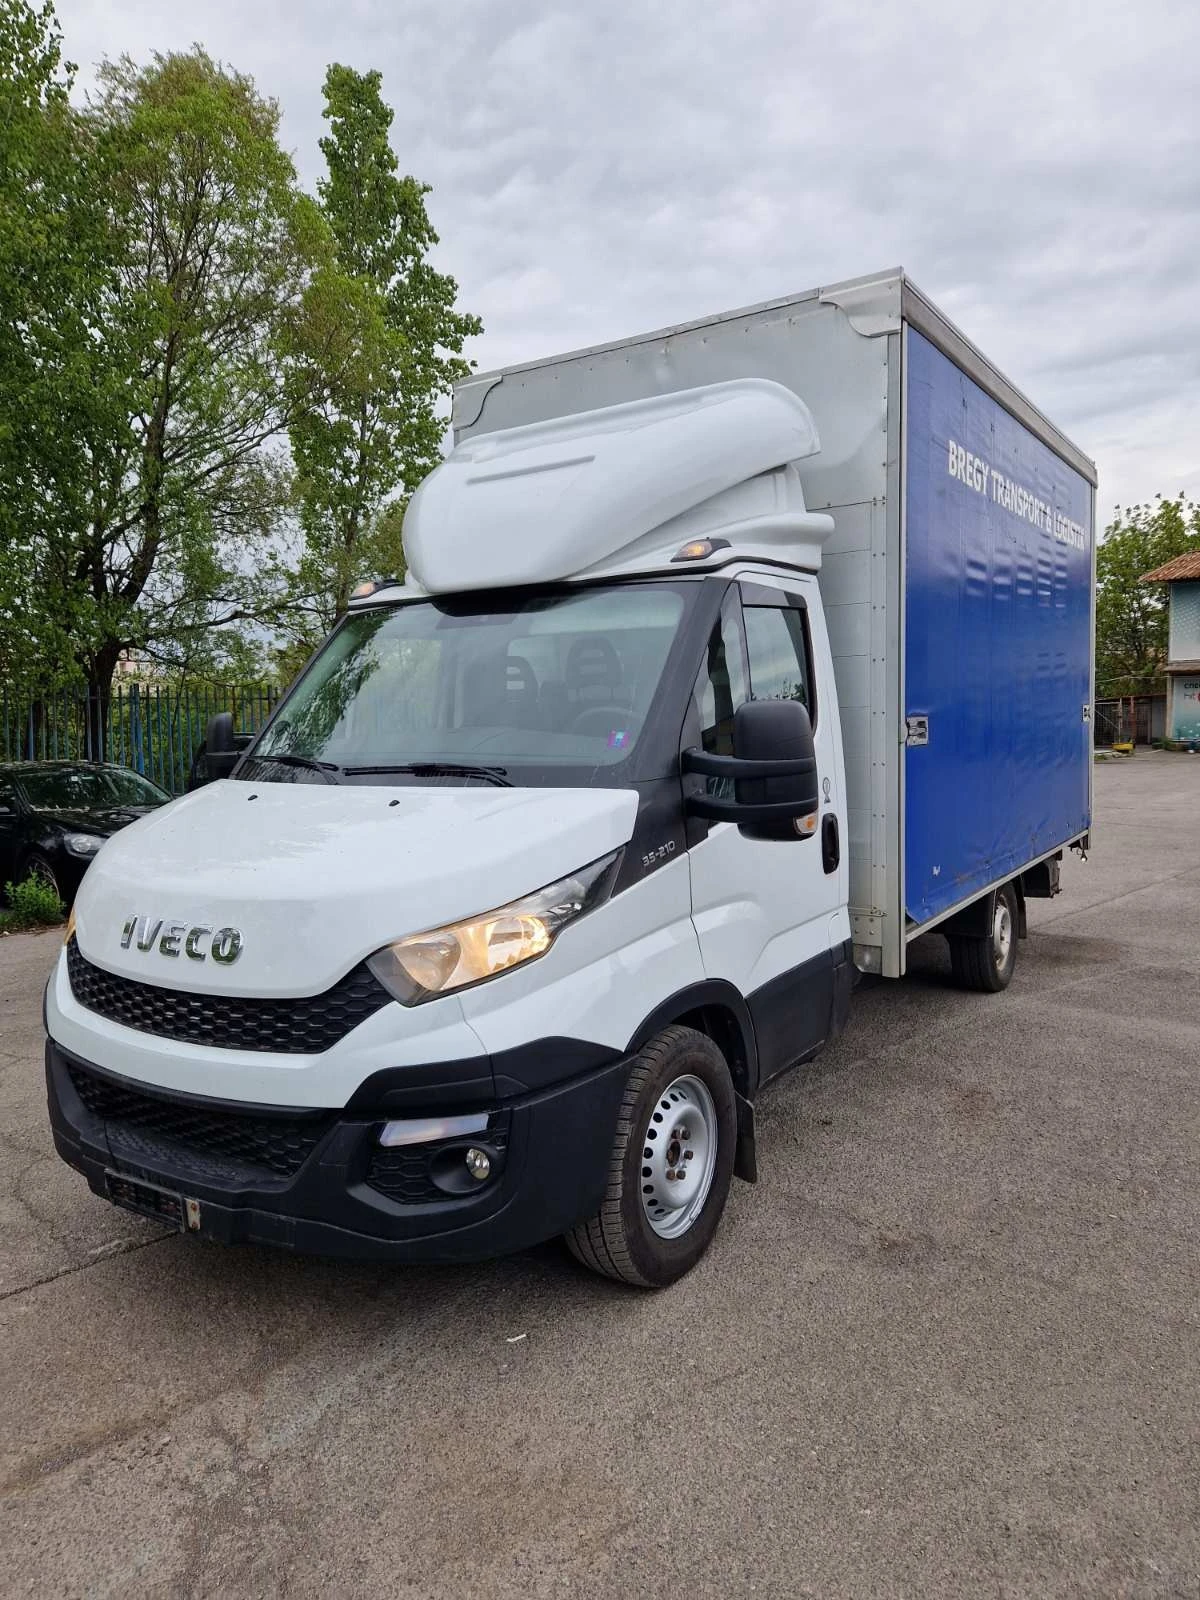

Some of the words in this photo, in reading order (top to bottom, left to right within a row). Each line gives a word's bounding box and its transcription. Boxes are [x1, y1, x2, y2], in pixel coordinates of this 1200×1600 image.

[948, 440, 989, 495] BREGY
[991, 470, 1046, 528] TRANSPORT
[642, 840, 676, 866] 35-210
[120, 913, 243, 965] IVECO
